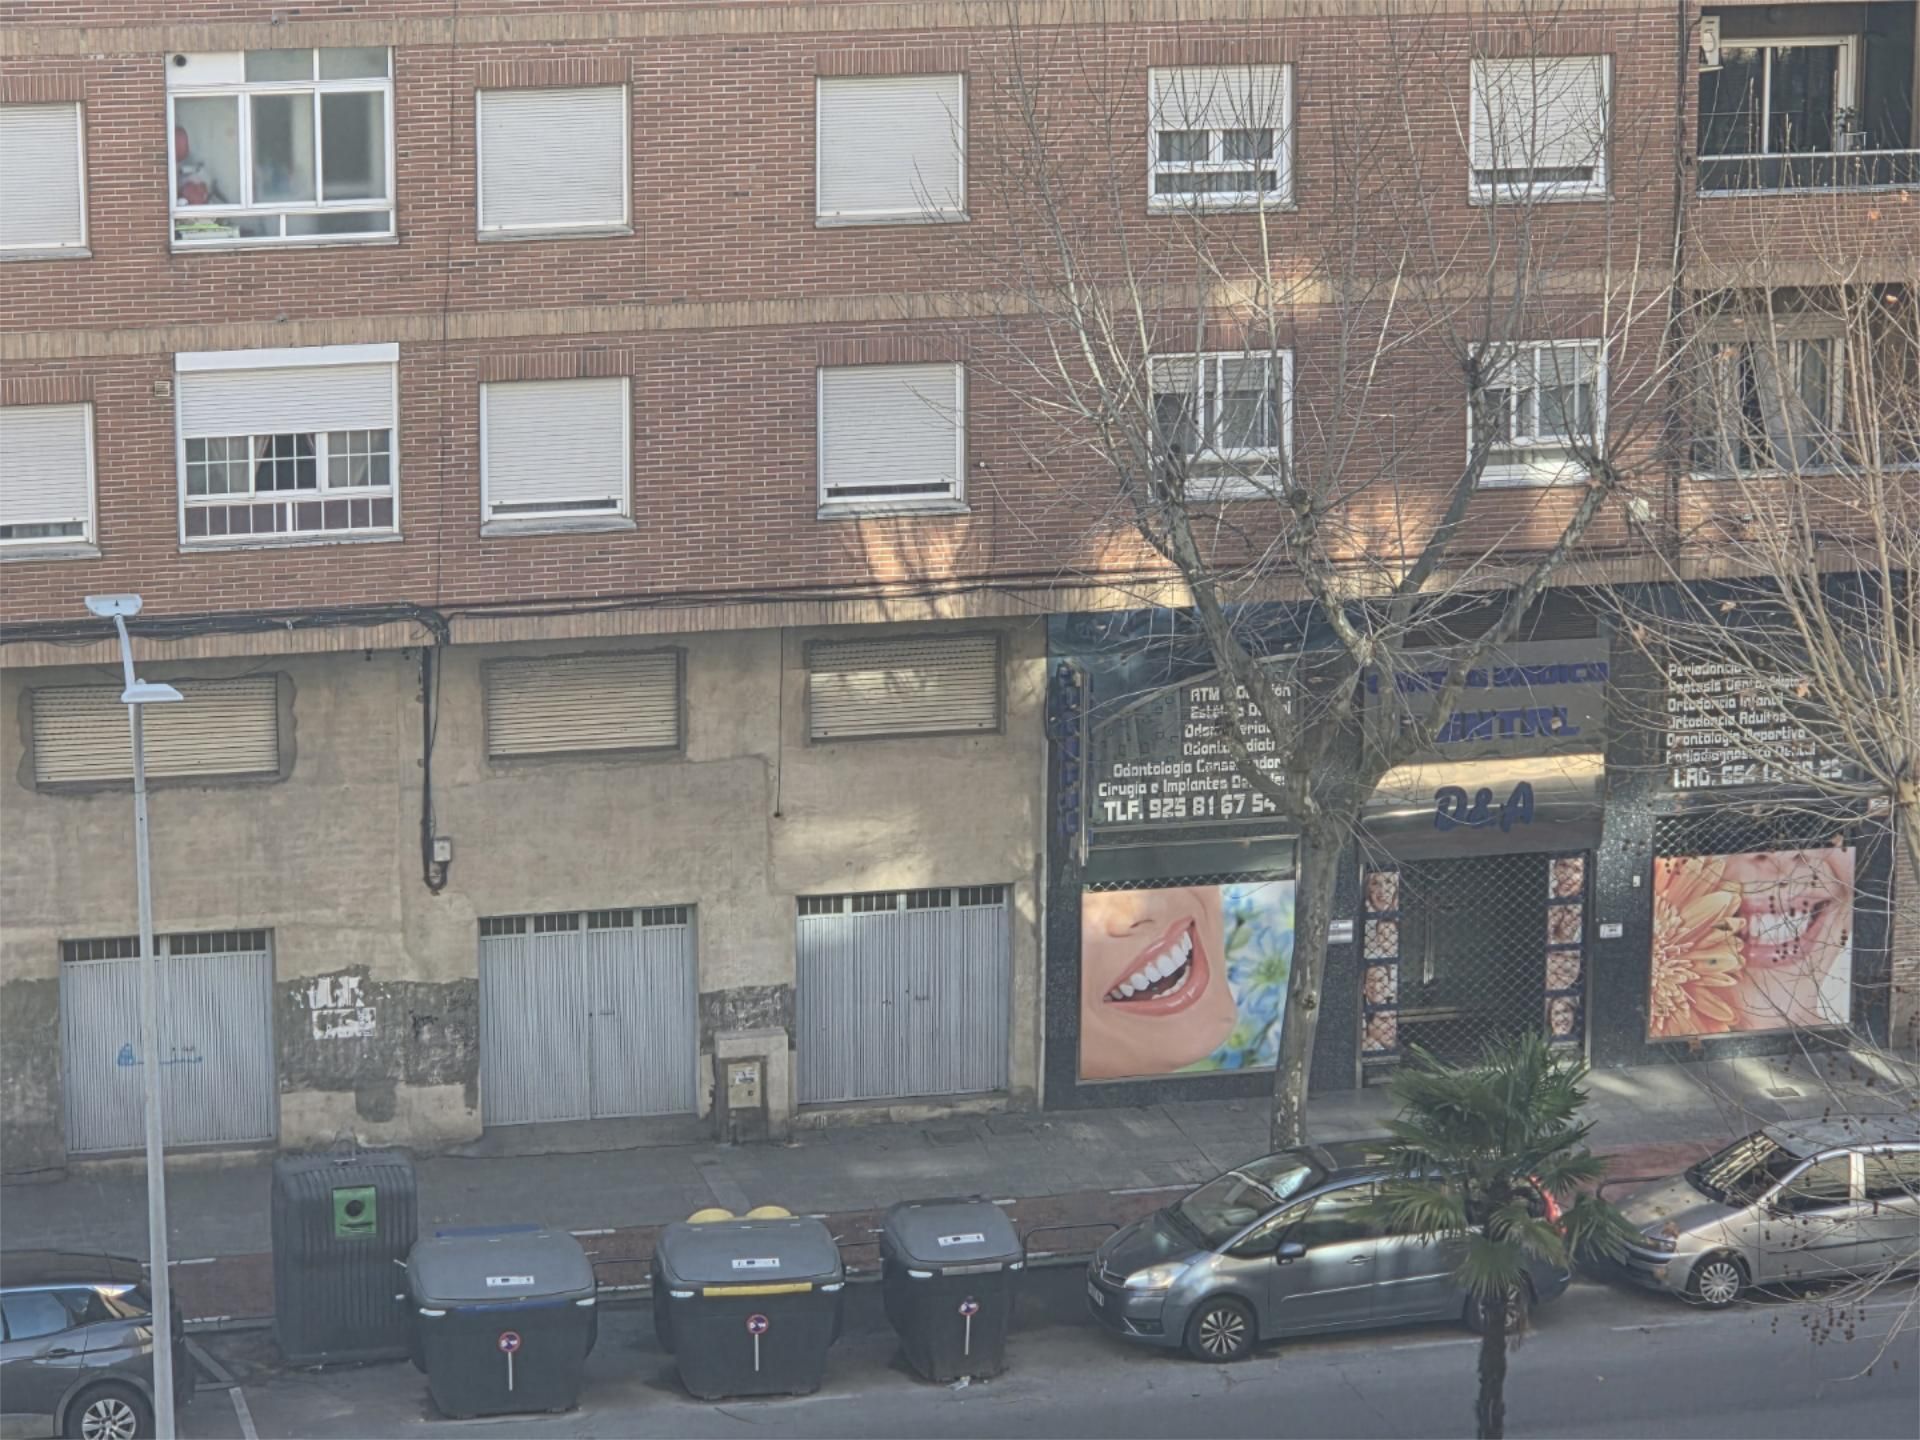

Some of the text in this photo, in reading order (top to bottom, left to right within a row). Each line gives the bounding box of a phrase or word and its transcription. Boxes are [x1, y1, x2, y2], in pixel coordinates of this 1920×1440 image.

[1190, 687, 1220, 702] ATM
[1667, 696, 1736, 713] Ortodoncia
[1402, 707, 1580, 743] ENTAL
[1739, 710, 1786, 725] Adultos
[1183, 738, 1275, 756] Odontodiat
[1667, 729, 1740, 748] Oontología
[1775, 741, 1815, 758] Detl
[1113, 756, 1281, 779] Odontología Consedor
[1151, 783, 1159, 794] e
[1163, 775, 1228, 795] Implantes
[1103, 800, 1144, 822] TLF.
[1150, 796, 1187, 819] 925
